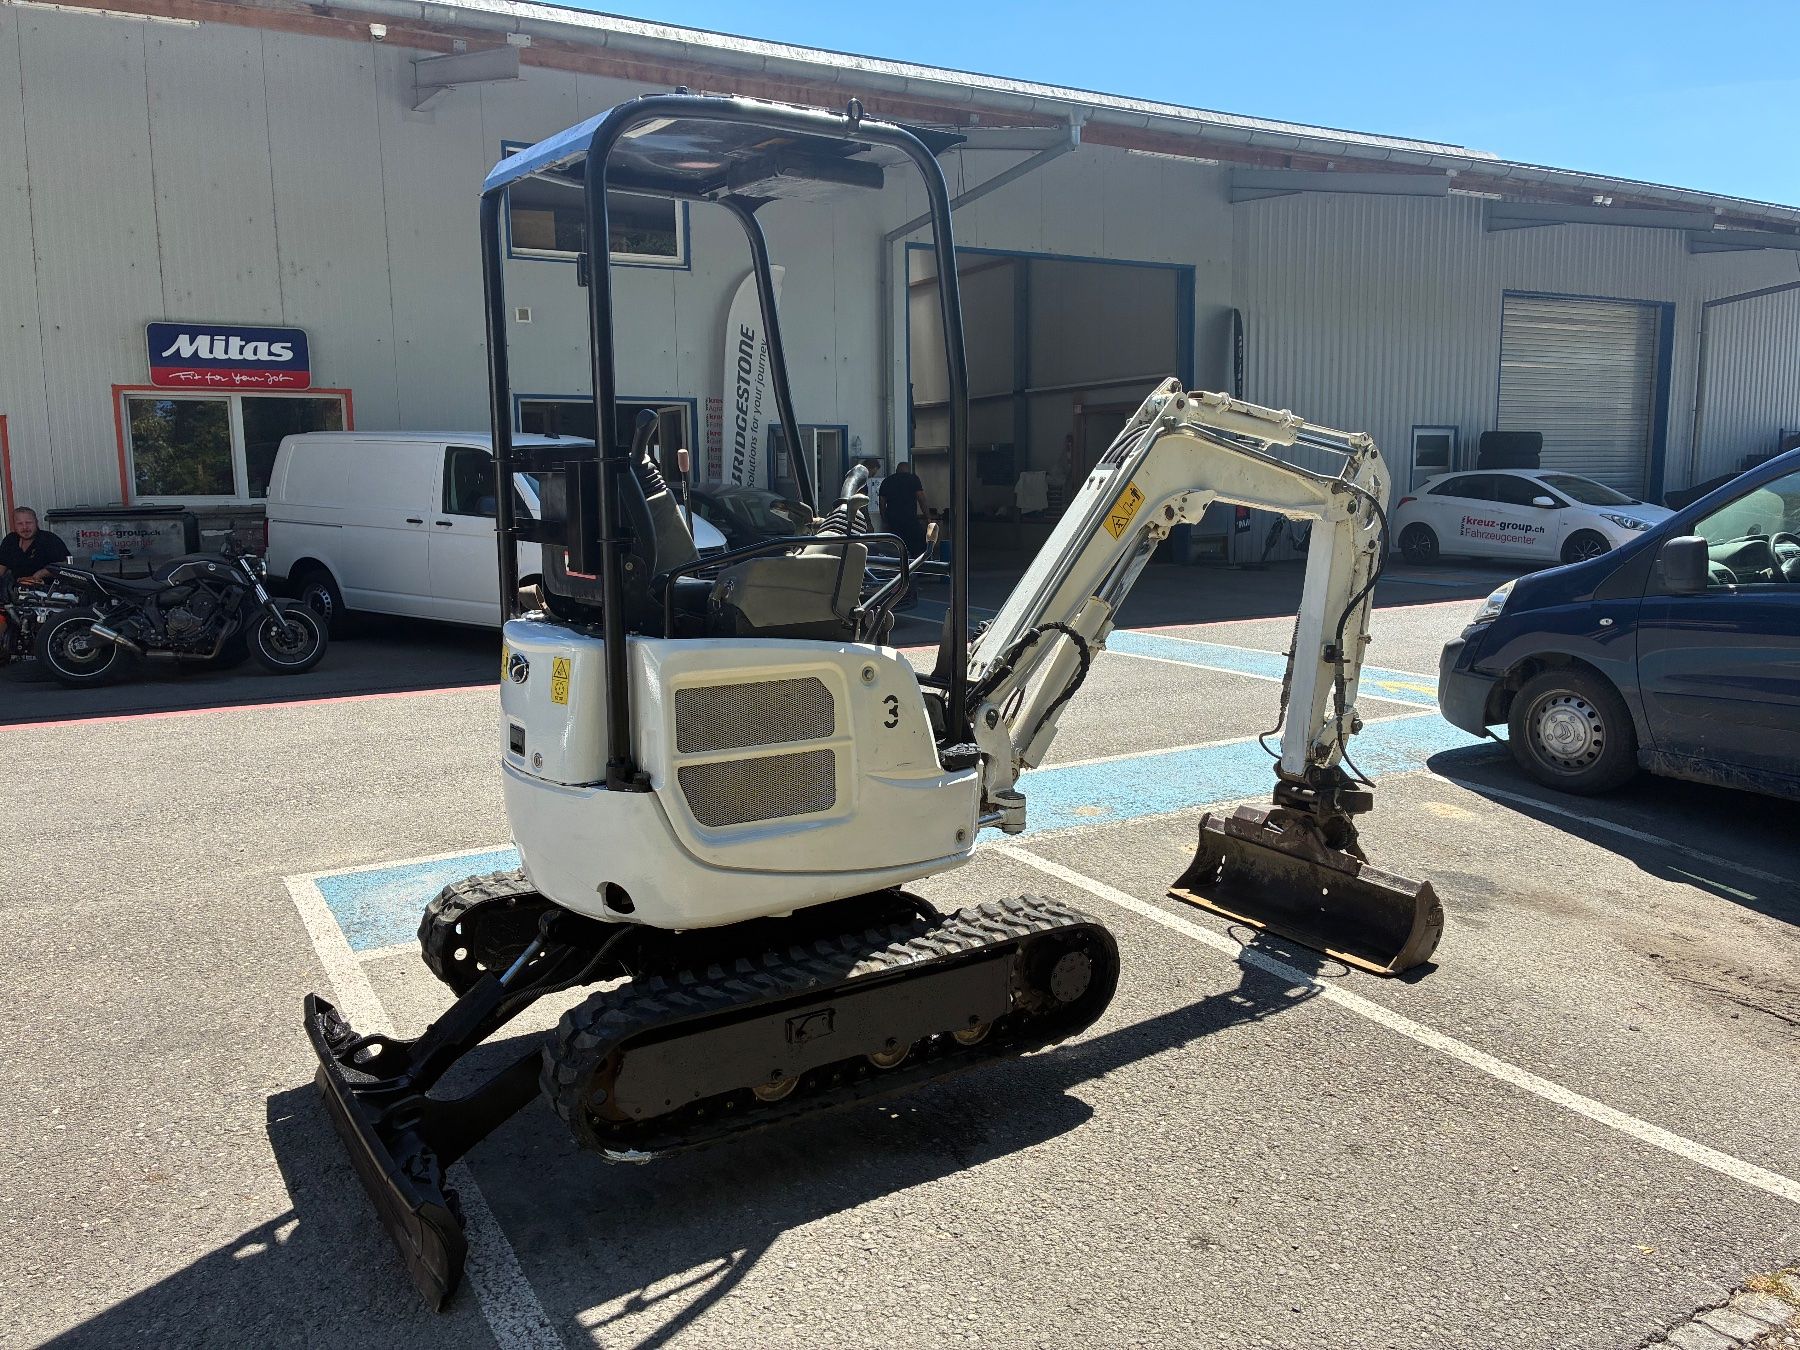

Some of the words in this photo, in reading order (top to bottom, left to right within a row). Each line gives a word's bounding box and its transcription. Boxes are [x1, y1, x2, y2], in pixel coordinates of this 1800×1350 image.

[162, 334, 294, 361] Mitas
[169, 371, 201, 381] Fit
[205, 372, 229, 384] for
[731, 323, 755, 488] BRIDGESTONE
[752, 386, 763, 416] your
[750, 417, 759, 434] for
[747, 436, 757, 488] Solutions
[1465, 528, 1536, 545] Fahrzeugcenter
[1466, 516, 1545, 533] kreuz-group.ch
[882, 695, 899, 729] 3
